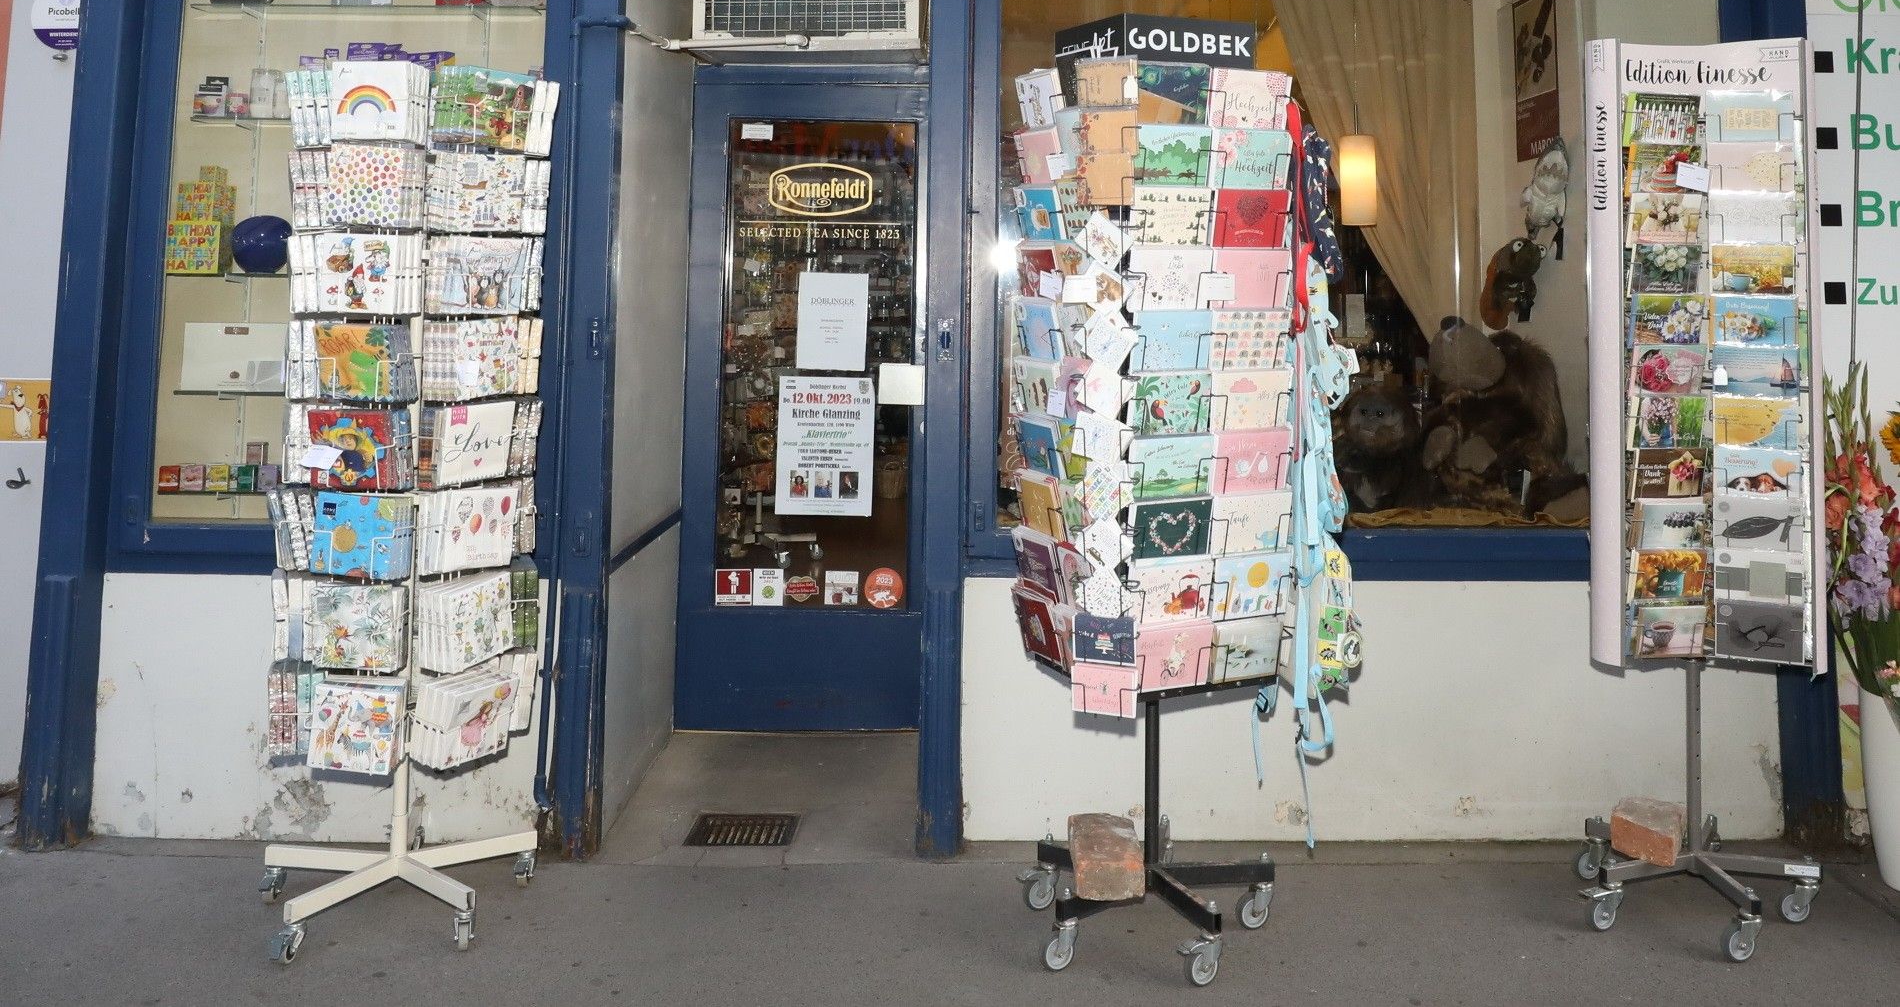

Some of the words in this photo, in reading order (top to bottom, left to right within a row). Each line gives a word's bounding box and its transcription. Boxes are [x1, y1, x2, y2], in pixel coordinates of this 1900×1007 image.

[1128, 27, 1251, 58] GOLDBEK
[1845, 37, 1900, 75] Kr
[1625, 59, 1692, 85] Edition
[1696, 60, 1773, 85] Finesse
[1592, 101, 1608, 153] Finesse
[1235, 159, 1274, 177] Hochzeit
[775, 174, 867, 206] Ronnefeldt
[1592, 154, 1608, 211] Edition
[739, 227, 801, 238] SELECTED
[805, 228, 829, 238] TEA
[832, 228, 870, 239] SINCE
[875, 229, 901, 239] 1823
[166, 260, 215, 270] HAPPY
[791, 408, 820, 419] Kirche
